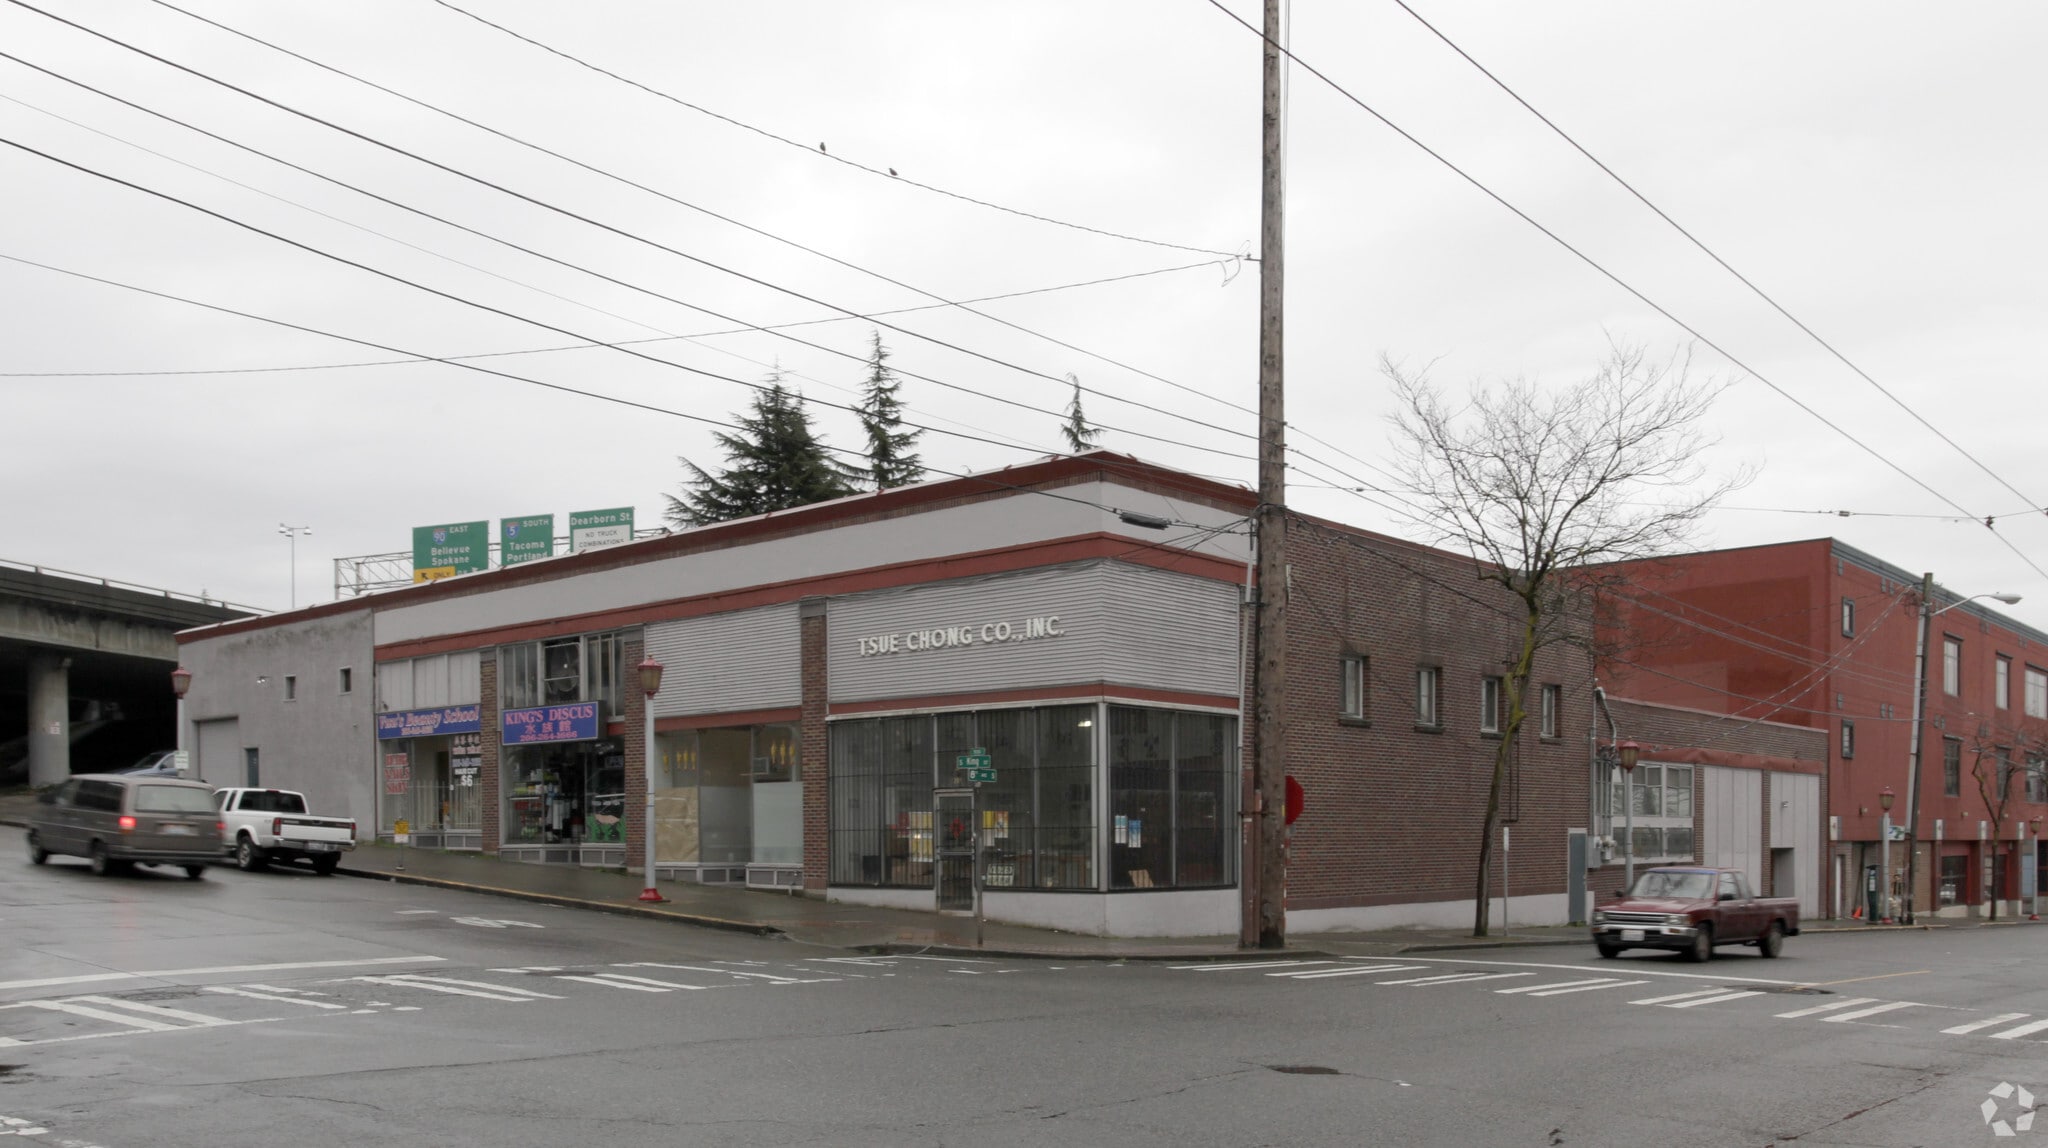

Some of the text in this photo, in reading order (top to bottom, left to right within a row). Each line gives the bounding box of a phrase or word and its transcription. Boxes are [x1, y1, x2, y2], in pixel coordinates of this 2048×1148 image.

[523, 519, 549, 528] SOUTH
[570, 514, 616, 527] Dearborn
[449, 525, 468, 534] EAST
[509, 525, 516, 535] 5
[433, 531, 445, 542] 90
[431, 545, 471, 556] Bellevue
[509, 541, 545, 551] Tacoma
[431, 556, 470, 566] Spokane
[506, 551, 548, 563] Portland
[858, 633, 899, 656] TSUE
[907, 626, 972, 650] CHONG
[406, 712, 442, 729] Beauty
[443, 705, 480, 724] School
[505, 705, 594, 725] KING'S DISCUS
[966, 757, 979, 768] King
[461, 774, 474, 787] $6
